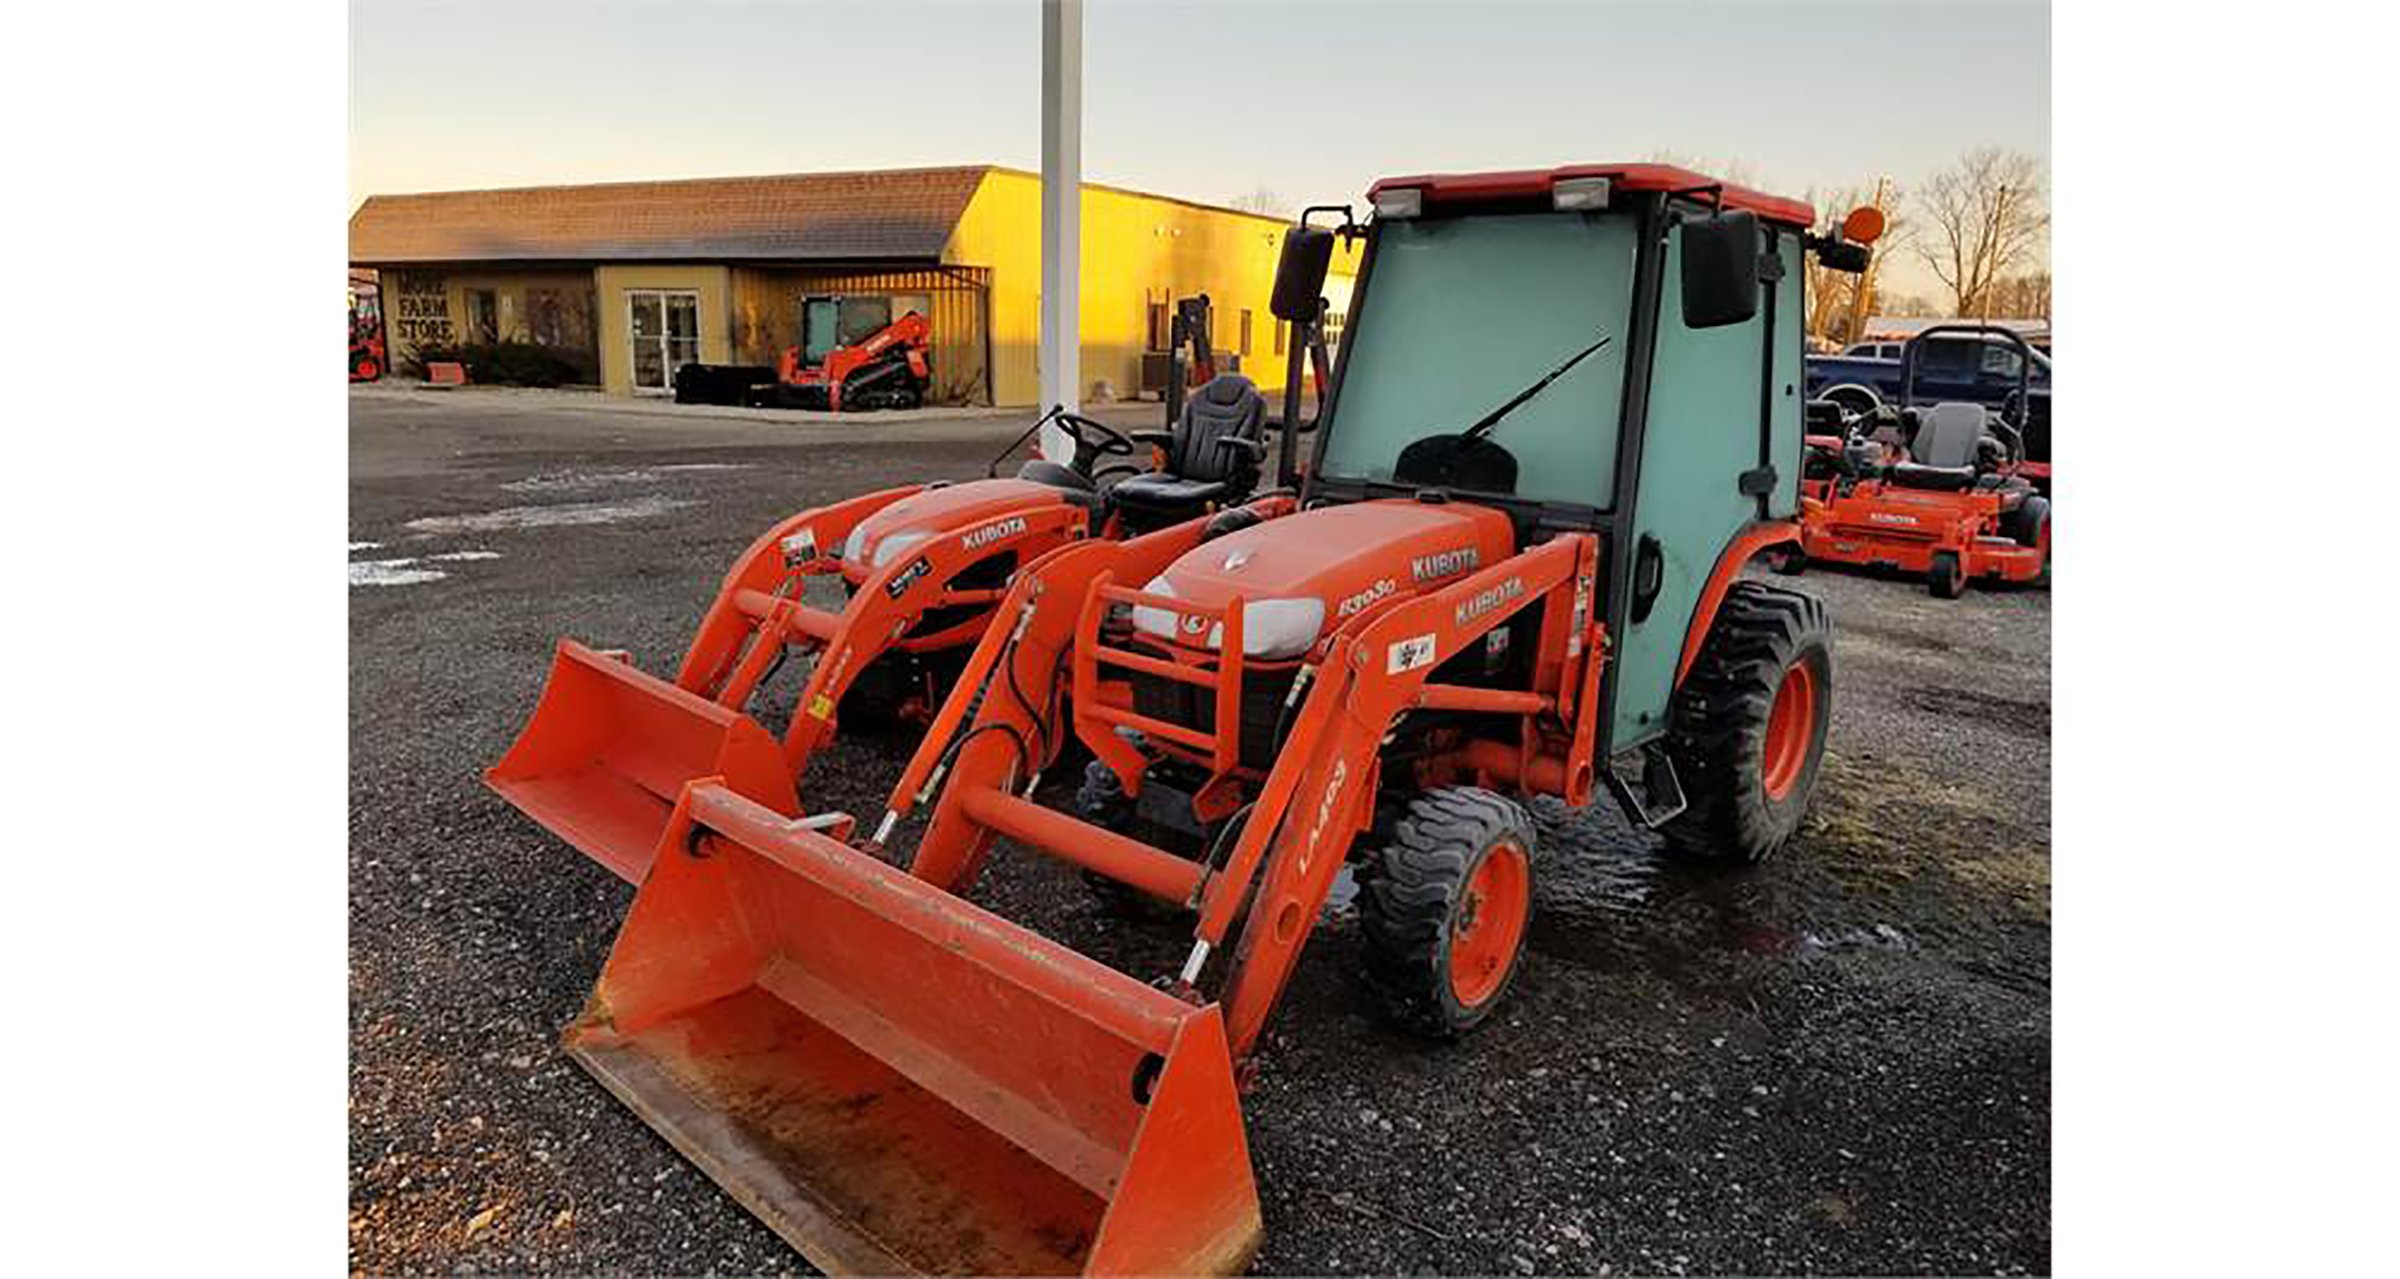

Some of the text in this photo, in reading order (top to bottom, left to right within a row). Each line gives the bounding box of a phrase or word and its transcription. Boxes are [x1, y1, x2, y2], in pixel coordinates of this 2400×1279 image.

[399, 298, 448, 317] FARM
[397, 320, 454, 339] STORE
[961, 517, 1027, 549] KUBOTA
[1412, 549, 1479, 580] KUBOTA
[1456, 577, 1524, 625] KUBOTA
